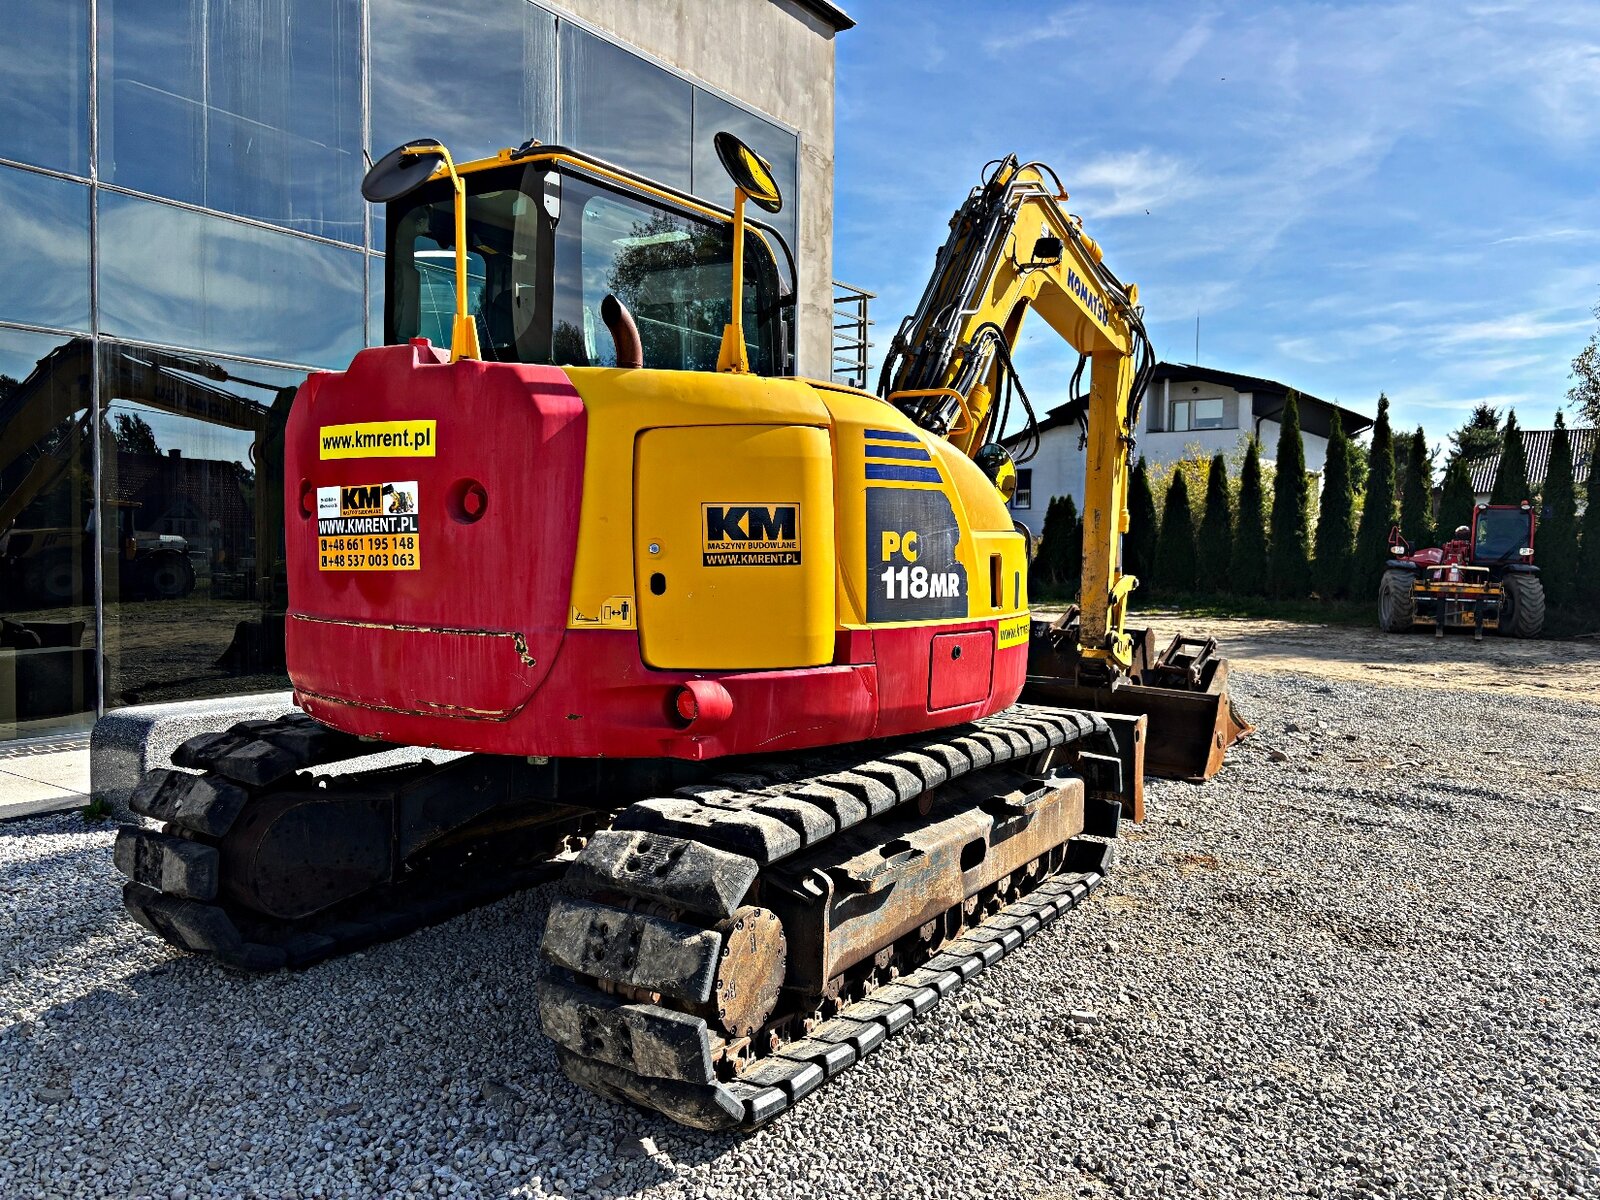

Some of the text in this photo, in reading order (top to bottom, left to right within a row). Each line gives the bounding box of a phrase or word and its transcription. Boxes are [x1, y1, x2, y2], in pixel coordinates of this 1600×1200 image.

[1067, 267, 1108, 327] KOMATSU
[322, 427, 430, 450] www.kmrent.pl
[342, 486, 381, 510] KM
[318, 516, 418, 535] WWW.KMRENT.PL
[707, 507, 796, 540] KM
[328, 537, 414, 551] +48 661 195 148
[707, 541, 797, 550] MASZYNY BUDOWLANE
[882, 530, 918, 563] PC
[328, 553, 415, 567] +48 537 003 063
[706, 553, 799, 565] WWW.KMRENT.PL
[881, 566, 960, 599] 118MR
